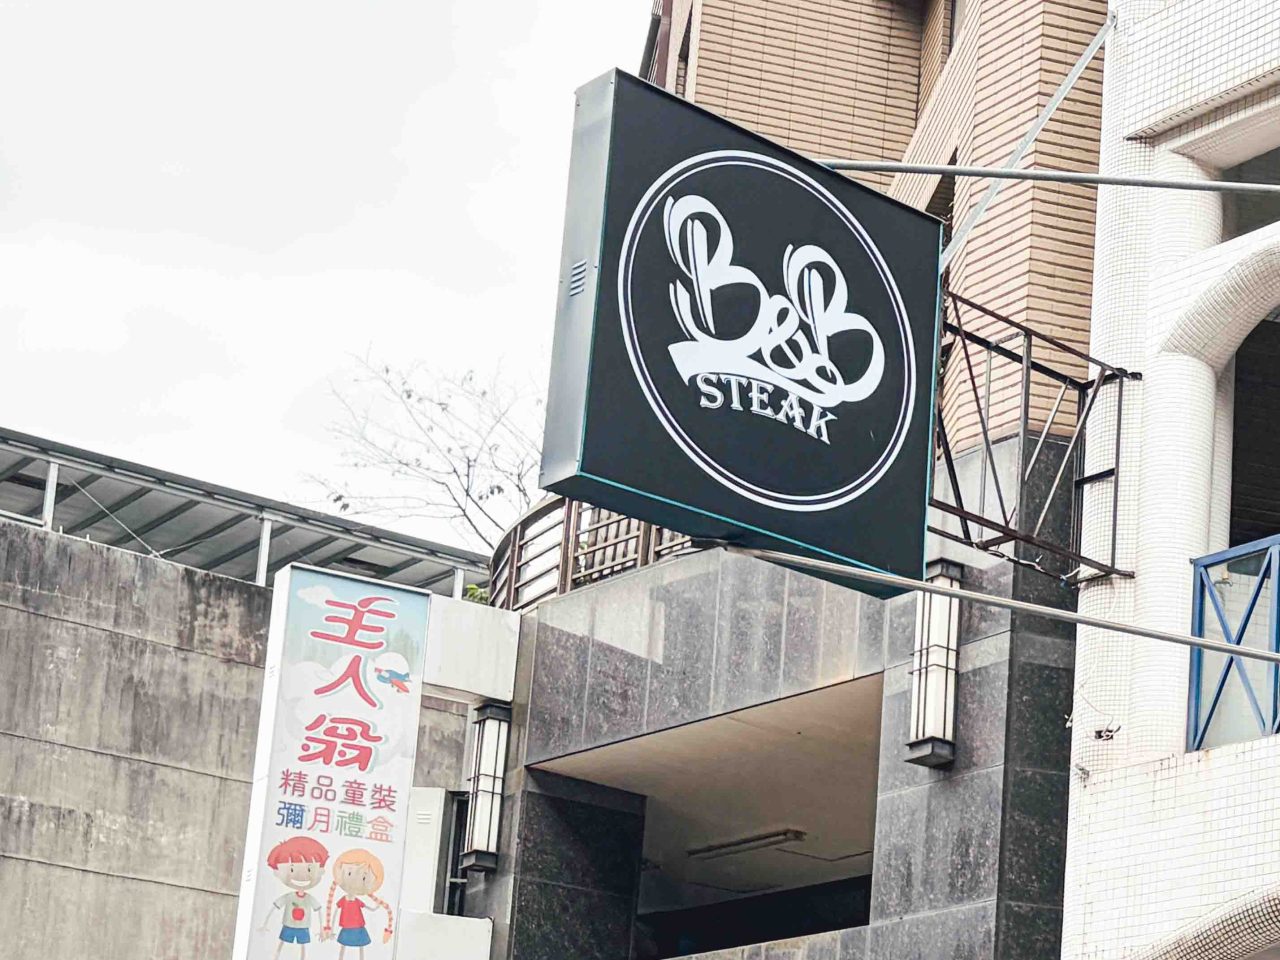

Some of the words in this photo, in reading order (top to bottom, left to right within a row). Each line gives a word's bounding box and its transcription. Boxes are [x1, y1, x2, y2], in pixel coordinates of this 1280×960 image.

[699, 372, 838, 446] STEAK
[297, 595, 397, 772] 主人翁
[278, 768, 398, 812] 精品童裝
[275, 800, 394, 843] 彌月禮盒
